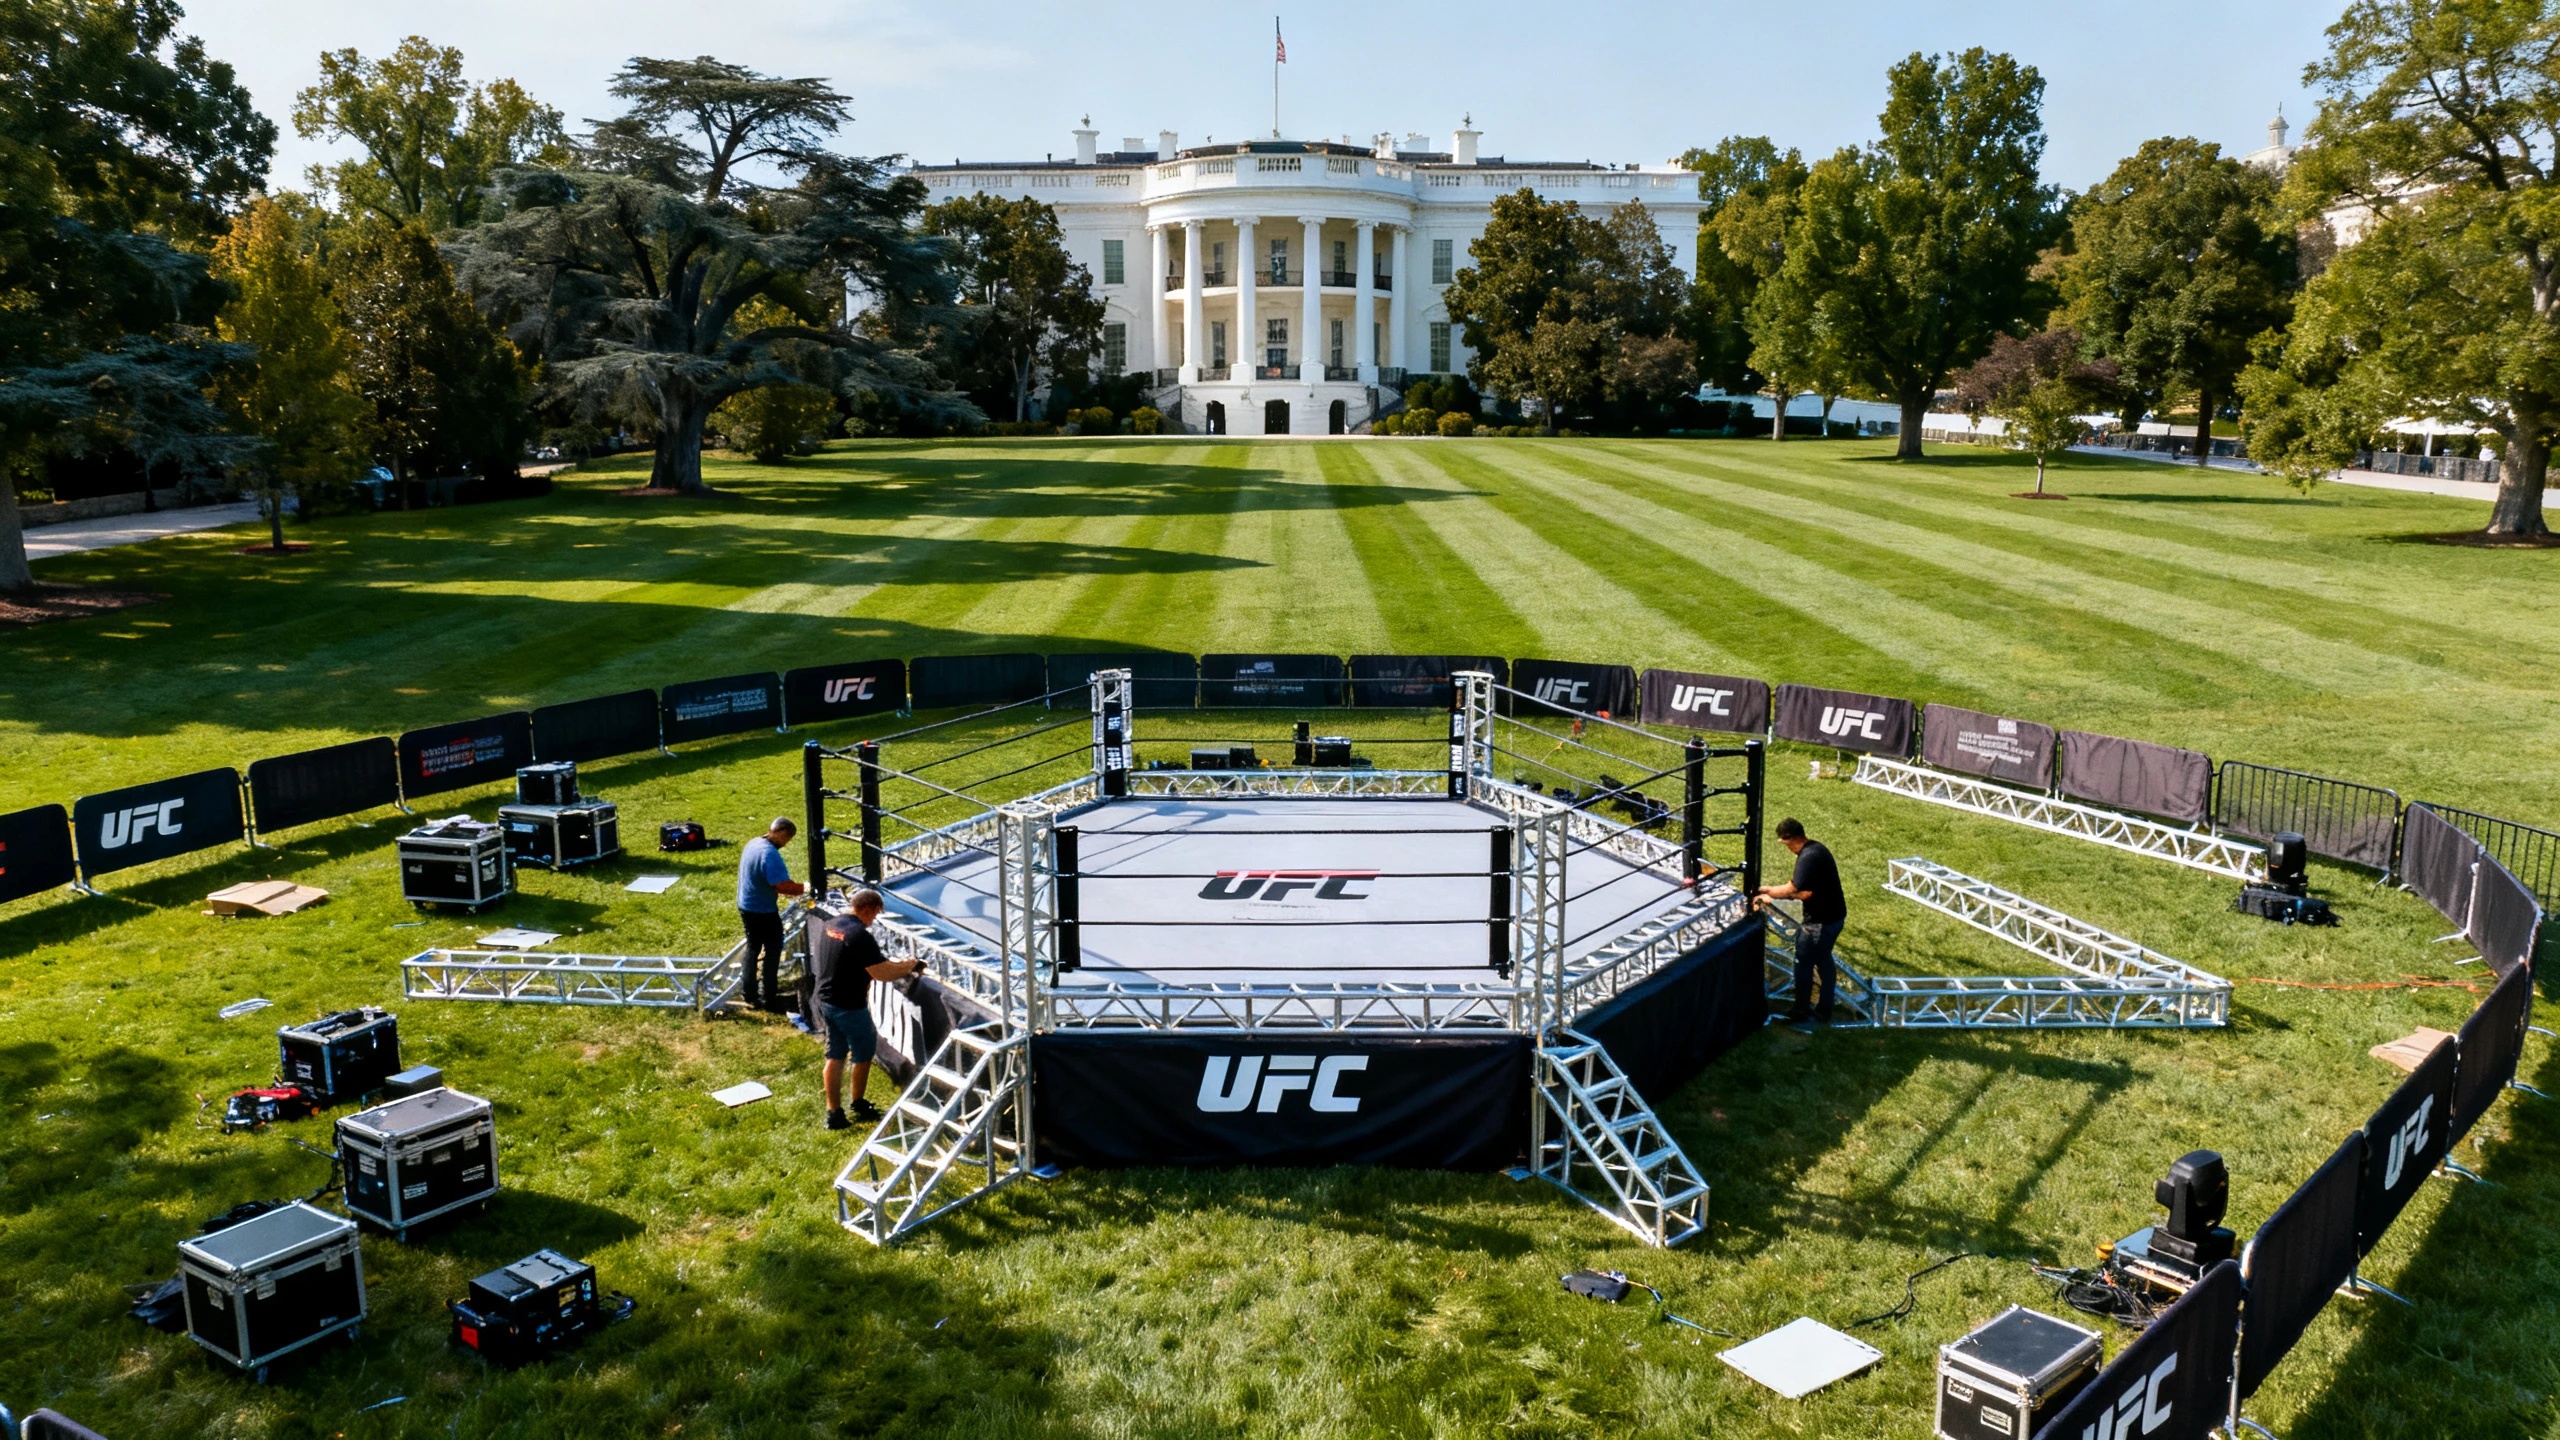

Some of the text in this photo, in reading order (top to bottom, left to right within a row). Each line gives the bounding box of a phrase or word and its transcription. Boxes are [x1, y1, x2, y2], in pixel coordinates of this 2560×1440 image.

[824, 677, 877, 703] UFC
[1534, 677, 1589, 703] UFC
[1671, 684, 1734, 716] UFC
[1819, 706, 1886, 740] UFC
[101, 797, 184, 849] UFC
[1198, 869, 1380, 901] UFC
[1197, 1055, 1370, 1113] UFC
[2384, 1093, 2434, 1190] UFC
